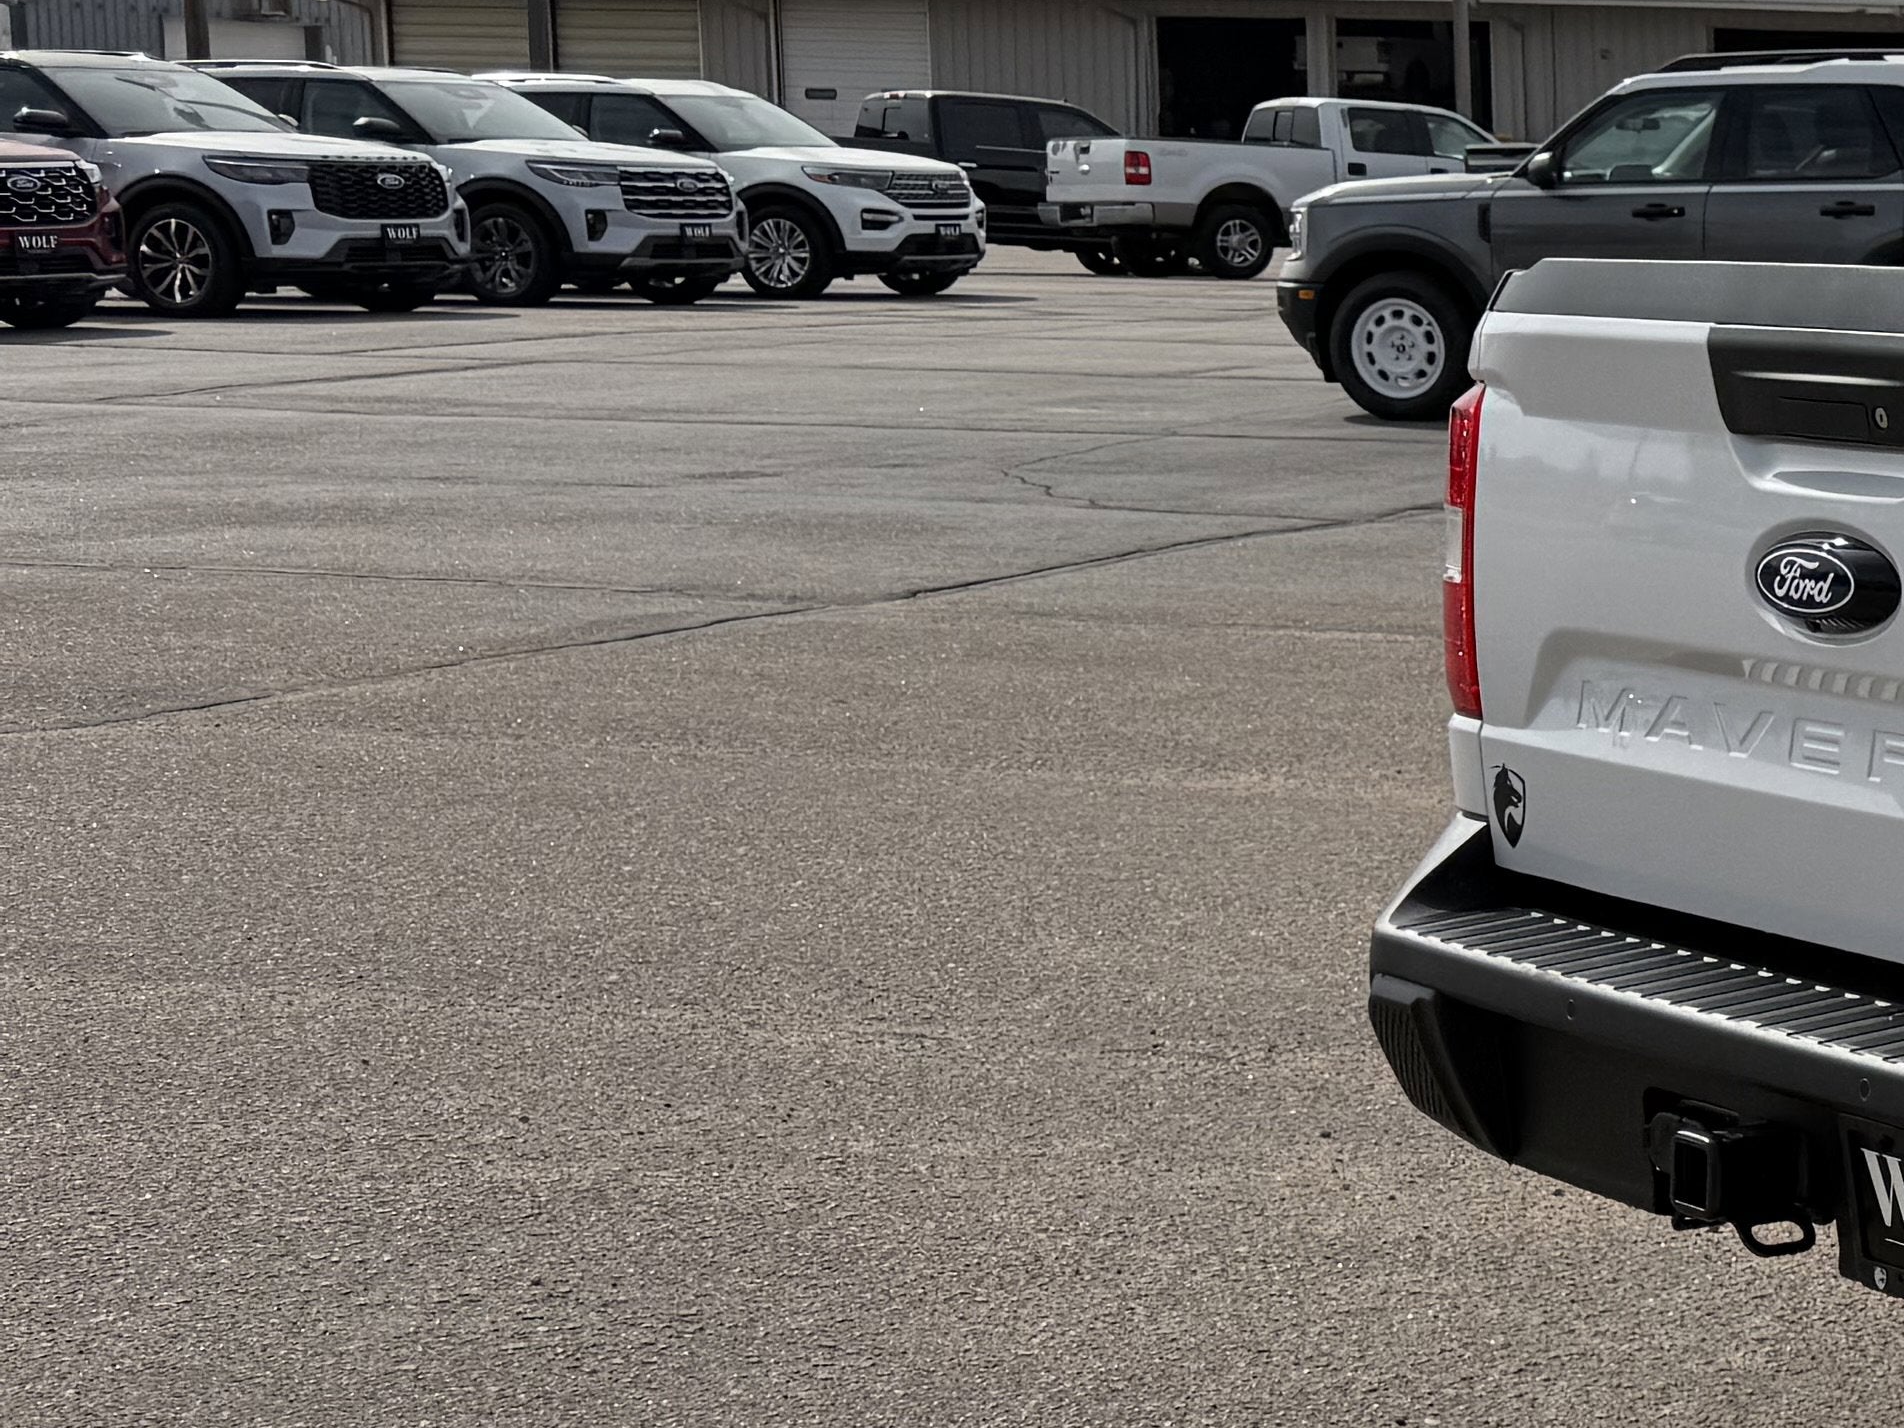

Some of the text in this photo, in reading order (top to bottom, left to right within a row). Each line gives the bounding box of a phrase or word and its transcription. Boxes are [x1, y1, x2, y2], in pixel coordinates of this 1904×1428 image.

[385, 227, 419, 240] WOLF
[18, 234, 59, 249] WOLF
[1773, 556, 1835, 604] Ford
